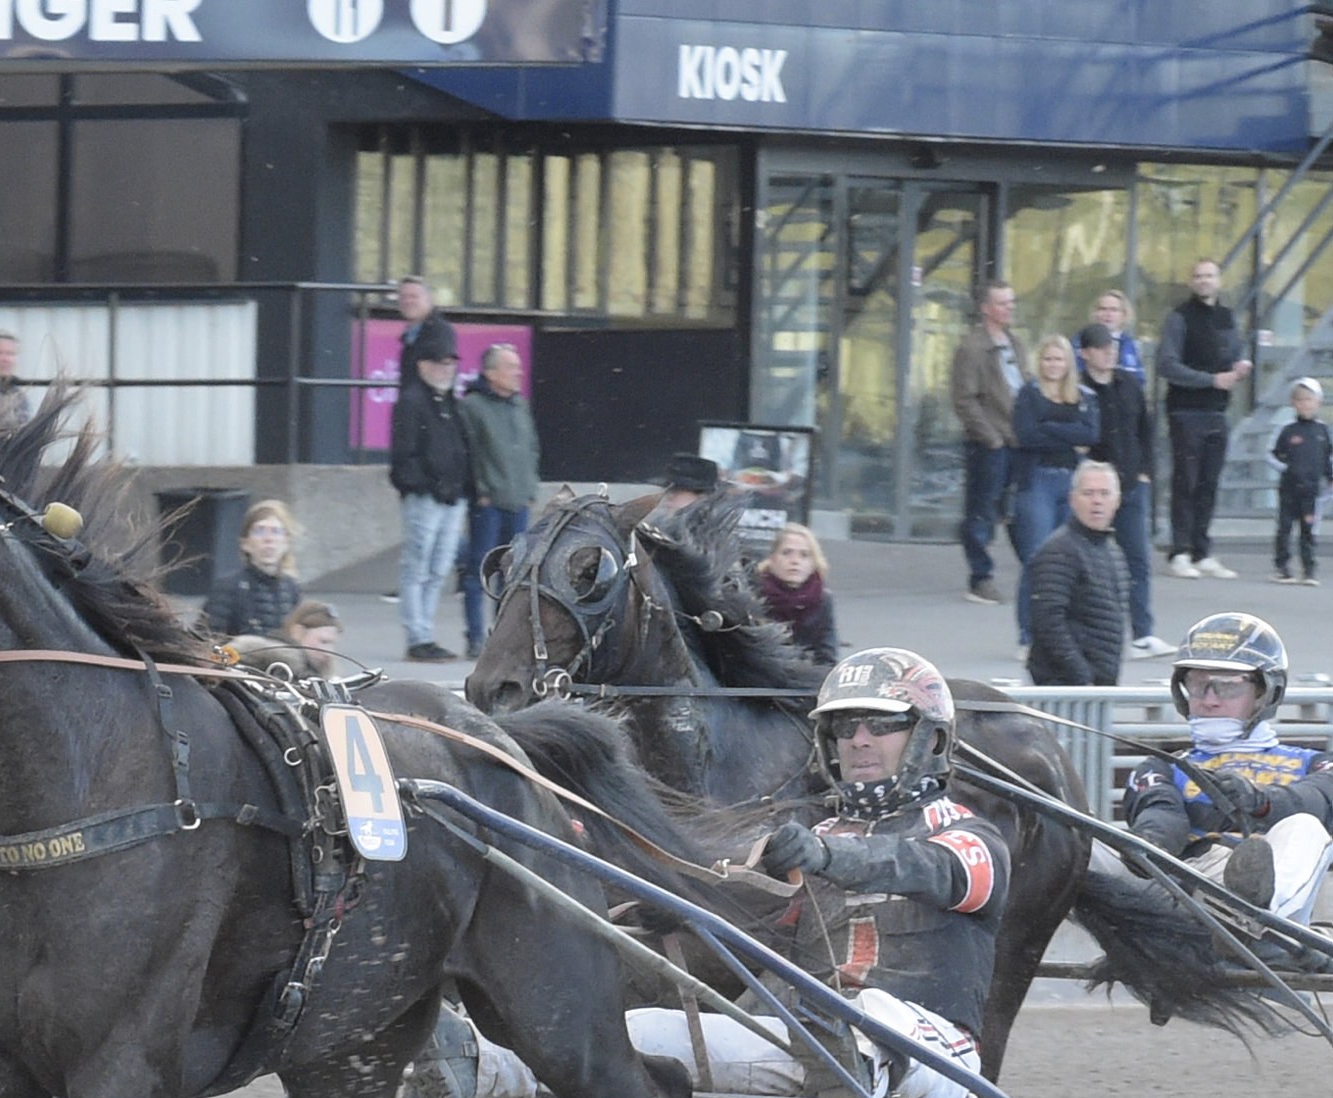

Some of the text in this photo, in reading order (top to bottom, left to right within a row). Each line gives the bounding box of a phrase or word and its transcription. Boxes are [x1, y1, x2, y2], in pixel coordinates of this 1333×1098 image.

[678, 44, 788, 103] KIOSK
[345, 715, 385, 813] 4
[23, 841, 47, 863] NO
[49, 831, 86, 858] ONE
